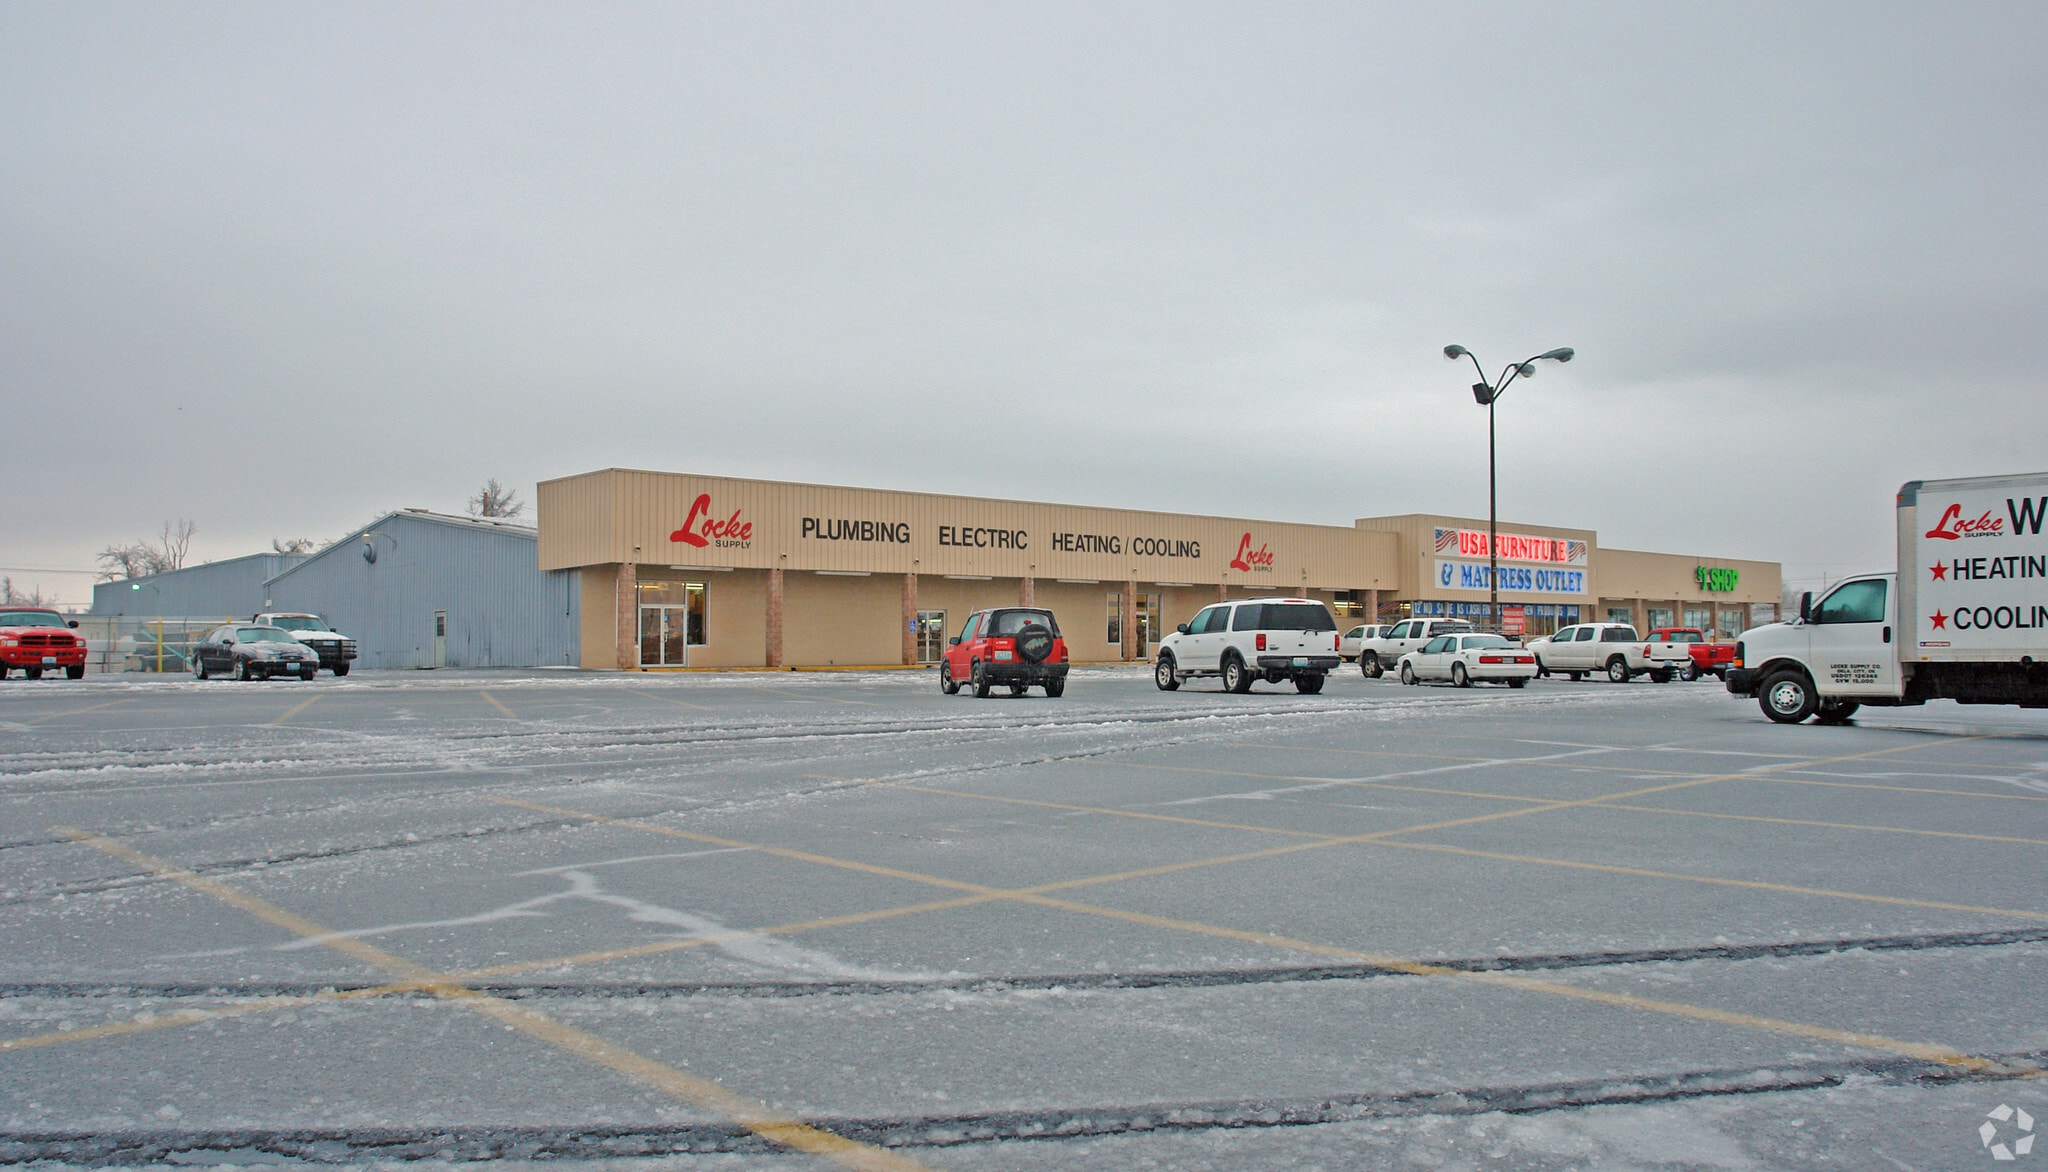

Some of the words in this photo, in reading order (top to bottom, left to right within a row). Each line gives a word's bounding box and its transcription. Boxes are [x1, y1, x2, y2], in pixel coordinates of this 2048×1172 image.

[670, 493, 752, 548] Locke
[1925, 503, 2003, 540] Locke
[715, 539, 751, 549] SUPPLY
[802, 517, 911, 543] PLUMBING
[938, 525, 1028, 550] ELECTRIC
[1052, 532, 1121, 554] HEATING
[1132, 537, 1201, 558] COOLING
[1230, 532, 1273, 572] Locke
[1459, 531, 1489, 556] USA
[1441, 563, 1453, 587] &
[1460, 564, 1532, 591] MATRESS
[1535, 569, 1583, 592] OUTLET
[1709, 567, 1739, 592] SHOP
[1953, 555, 2046, 580] HEATIN
